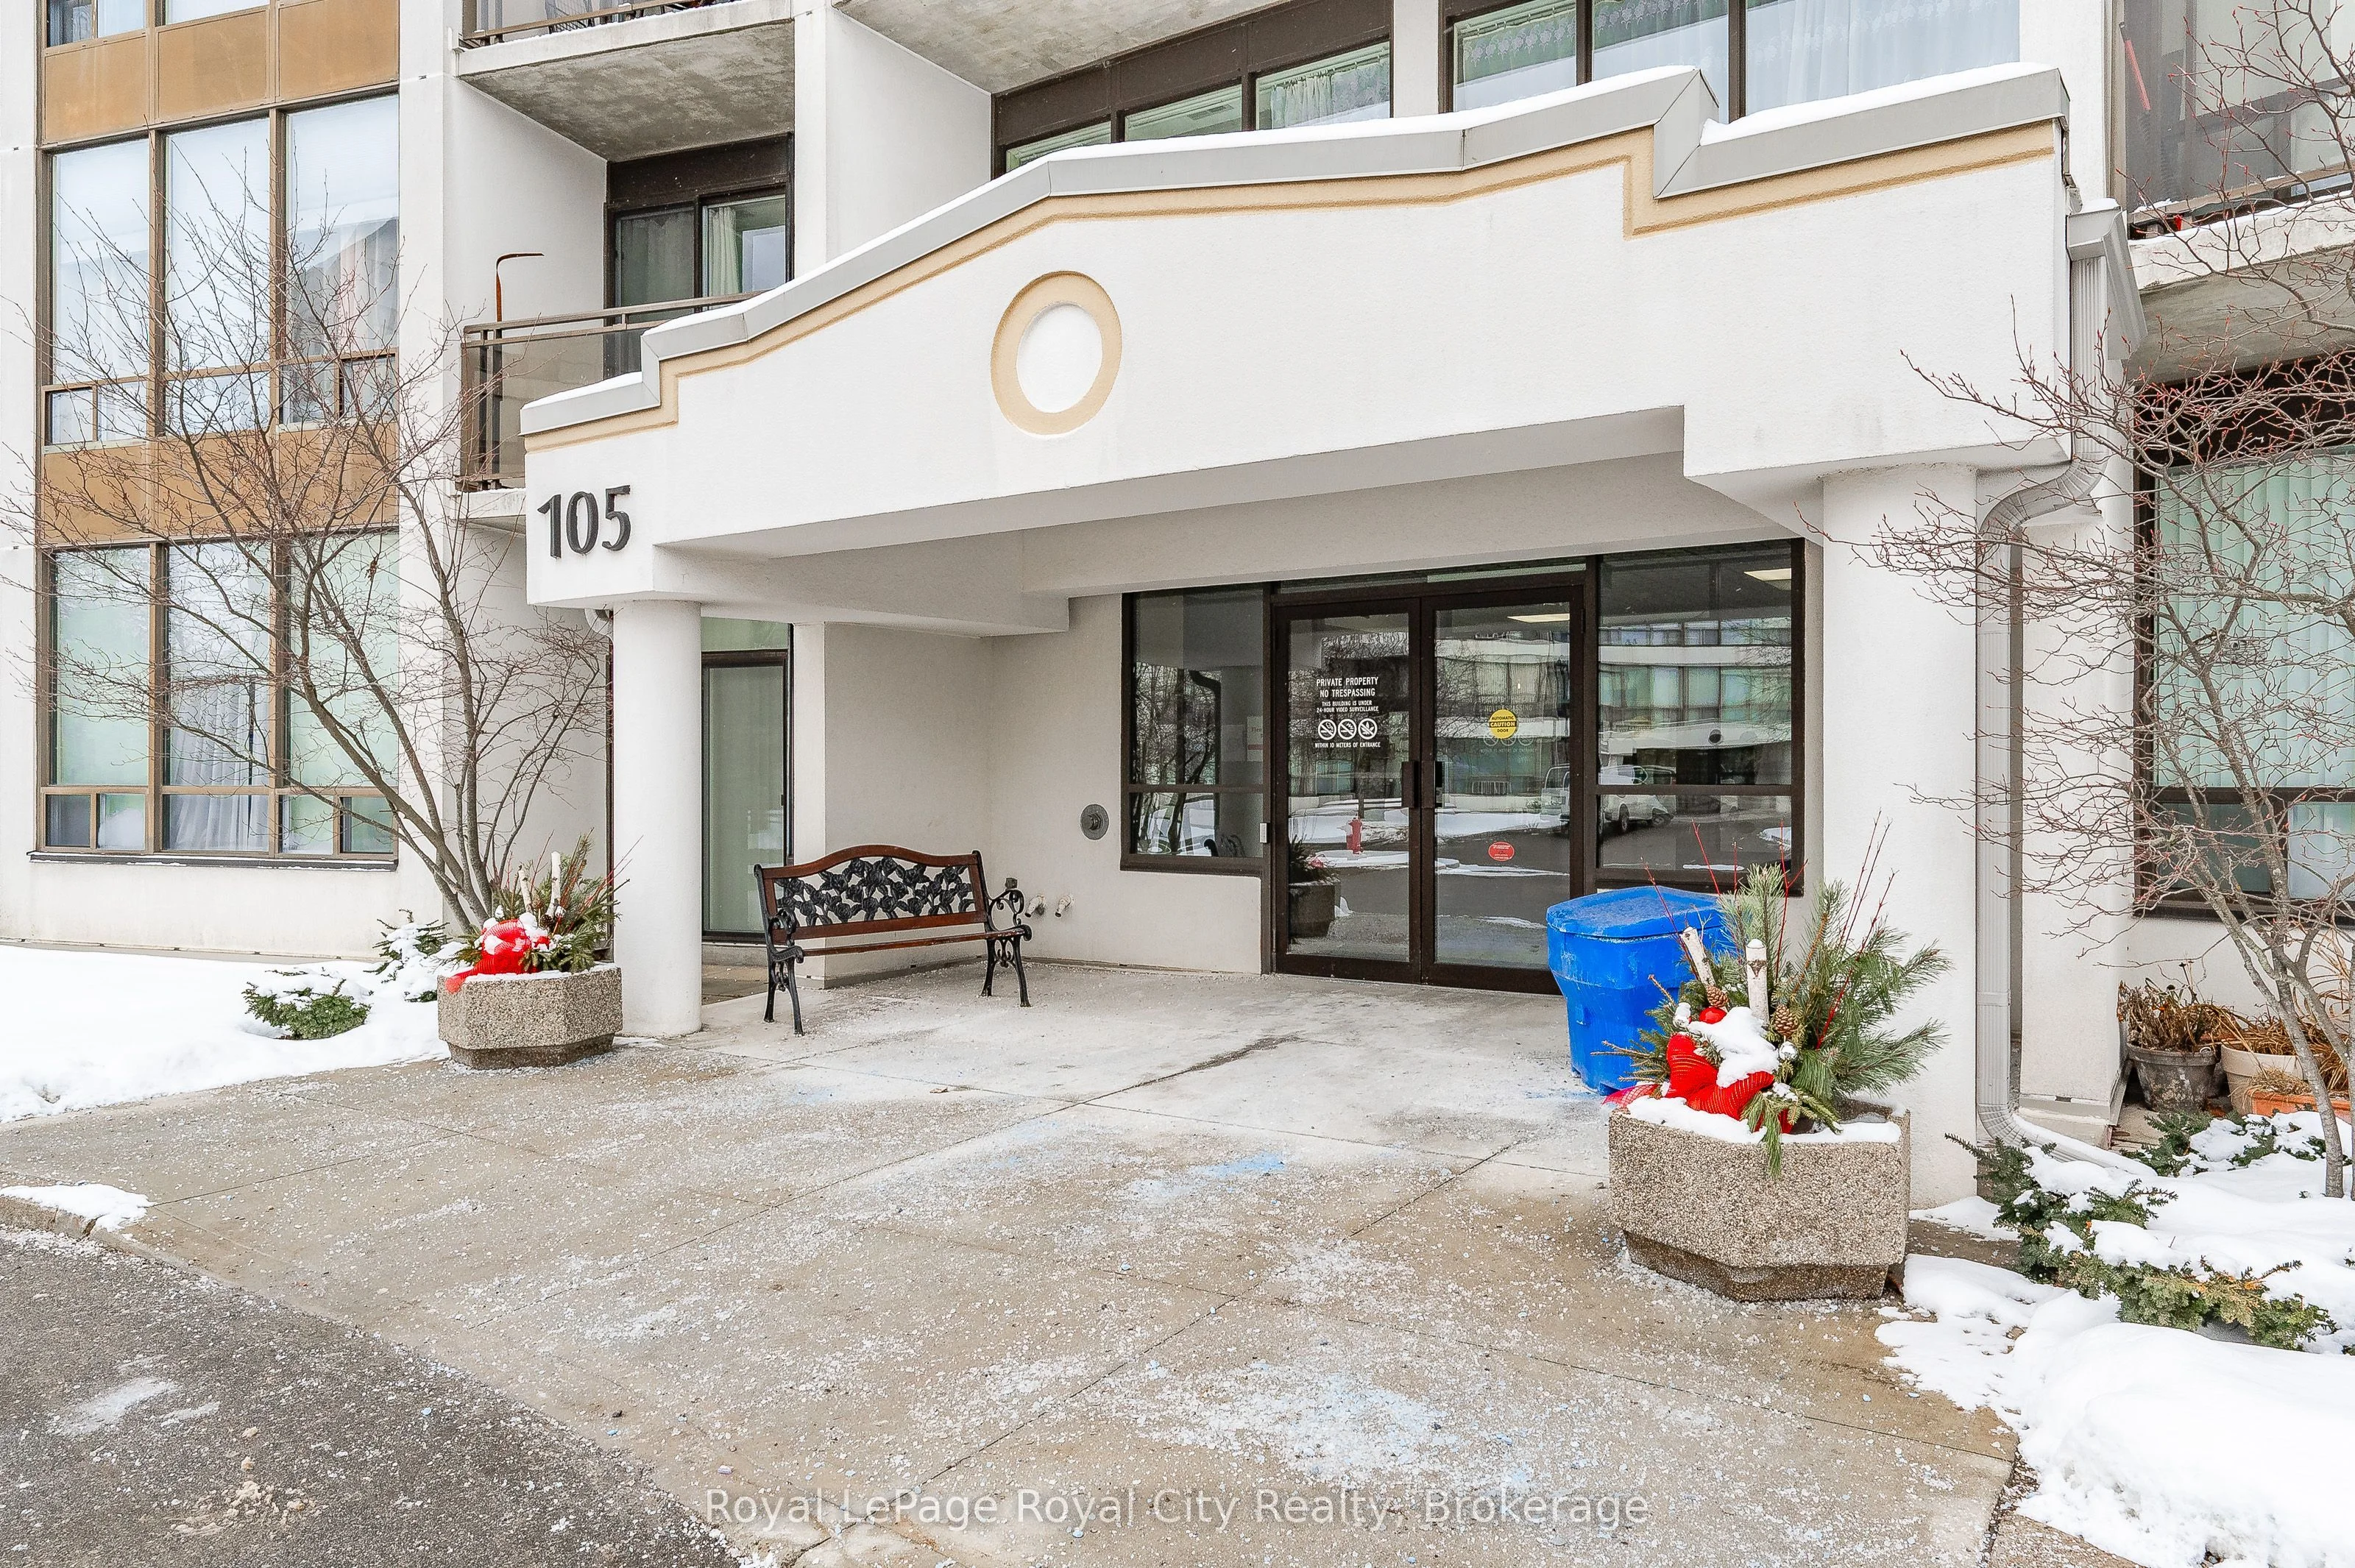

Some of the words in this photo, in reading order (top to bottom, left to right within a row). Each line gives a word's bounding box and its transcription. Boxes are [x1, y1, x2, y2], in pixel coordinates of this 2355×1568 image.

[536, 484, 631, 559] 105
[1316, 678, 1342, 687] PRIVATE
[1345, 676, 1378, 686] PROPERTY
[1320, 689, 1329, 698] NO
[1331, 688, 1375, 698] TRESPASSING
